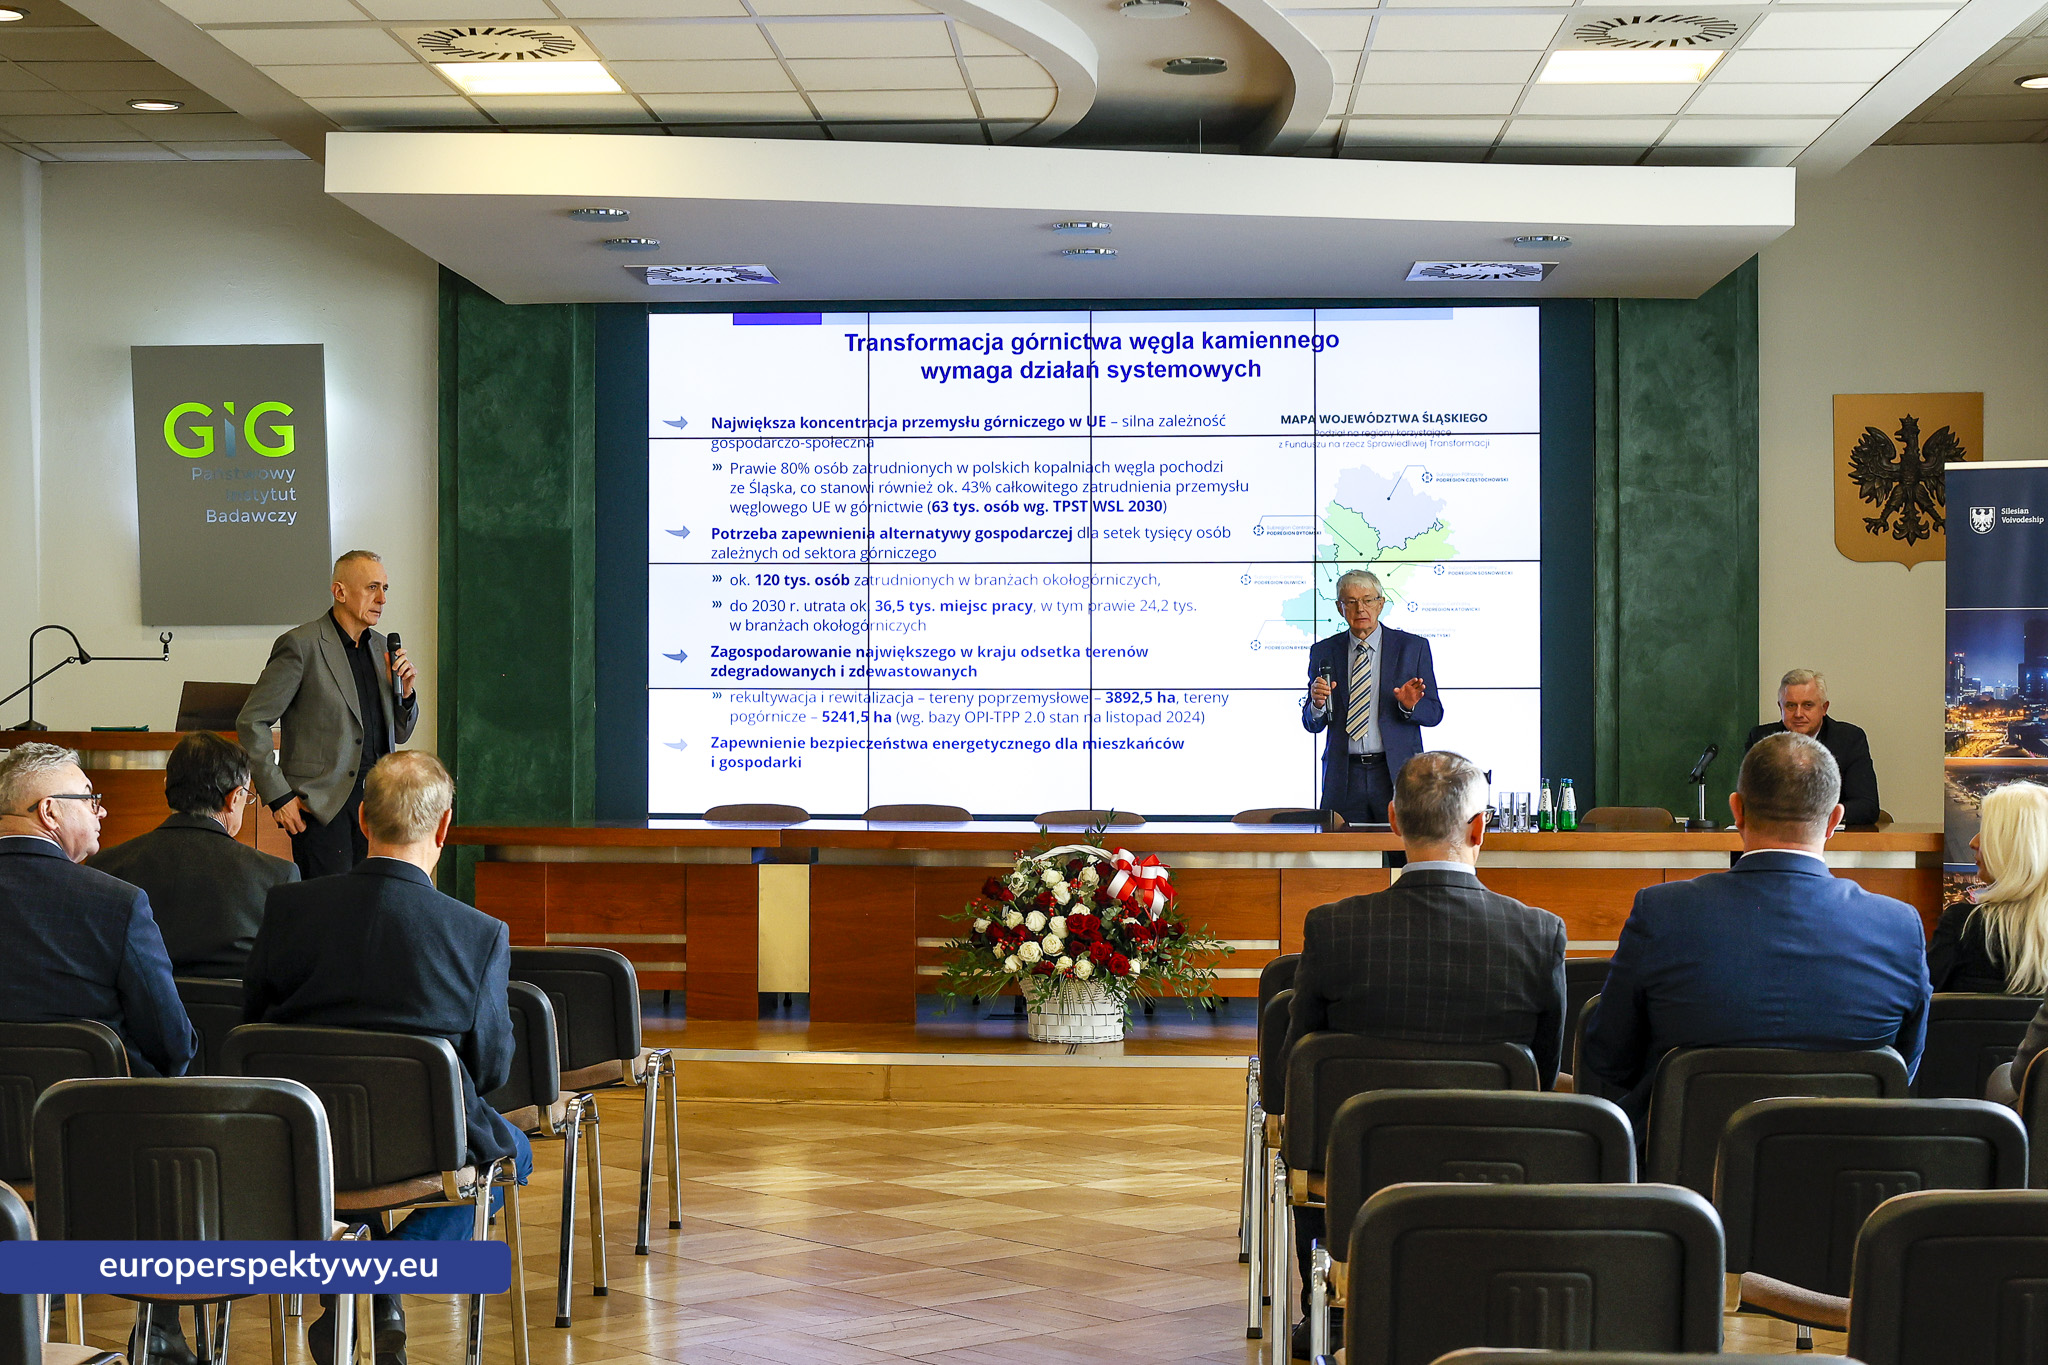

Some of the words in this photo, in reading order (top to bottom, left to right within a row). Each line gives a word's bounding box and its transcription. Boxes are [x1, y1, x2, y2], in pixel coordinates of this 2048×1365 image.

[845, 333, 1002, 354] Transformacja
[1011, 333, 1121, 354] górnictwa
[1130, 332, 1194, 353] węgla
[1202, 331, 1340, 352] kamiennego
[921, 365, 1013, 384] wymaga
[1020, 361, 1099, 379] działań
[1107, 359, 1261, 382] systemowych
[712, 417, 796, 432] Największa
[800, 416, 897, 431] koncentracja
[902, 416, 979, 431] przemysłu
[984, 416, 1065, 431] górniczego
[1069, 418, 1082, 427] w
[1087, 416, 1106, 427] UE
[1123, 415, 1154, 427] silna
[1159, 414, 1226, 430] zależność
[1281, 415, 1315, 424] MAPA
[1319, 412, 1419, 424] WOJEWÓDZTWA
[1423, 412, 1488, 425] ŚLĄSKIEGO
[712, 436, 874, 452] gospodarczo-społeczna
[1367, 440, 1427, 449] Sprawiedliwej
[1430, 440, 1490, 449] Transformacji
[730, 462, 776, 474] Prawie
[781, 463, 810, 474] 80%
[814, 461, 848, 474] osób
[853, 461, 952, 478] zatrudnionych
[957, 464, 968, 473] w
[973, 461, 1029, 478] polskich
[1034, 460, 1110, 477] kopalniach
[1115, 460, 1155, 476] węgla
[1159, 460, 1223, 476] pochodzi
[730, 484, 744, 494] ze
[749, 478, 796, 498] Śląska,
[800, 484, 816, 494] co
[820, 481, 874, 494] stanowi
[879, 481, 933, 494] również
[937, 481, 958, 493] ok.
[962, 481, 991, 493] 43%
[996, 480, 1078, 496] całkowitego
[1083, 480, 1171, 494] zatrudnienia
[1176, 479, 1249, 496] przemysłu
[730, 500, 807, 517] węglowego
[812, 502, 831, 514] UE
[835, 504, 846, 513] w
[850, 500, 923, 517] górnictwie
[927, 500, 949, 516] (63
[953, 501, 979, 517] tys.
[984, 500, 1019, 513] osób
[1024, 503, 1048, 516] wg.
[1053, 501, 1088, 513] TPST
[1092, 500, 1124, 512] WSL
[1128, 500, 1167, 515] 2030)
[206, 509, 297, 525] Badawczy
[2002, 516, 2044, 524] Voivodeship
[712, 527, 777, 541] Potrzeba
[782, 527, 875, 543] zapewnienia
[880, 527, 971, 542] alternatywy
[975, 527, 1073, 542] gospodarczej
[1077, 526, 1099, 538] dla
[1103, 526, 1140, 538] setek
[1144, 527, 1192, 542] tysięcy
[1196, 526, 1231, 538] osób
[712, 546, 777, 562] zależnych
[782, 546, 800, 559] od
[804, 546, 856, 559] sektora
[860, 547, 937, 562] górniczego
[730, 574, 750, 586] ok.
[756, 574, 780, 586] 120
[784, 575, 810, 589] tys.
[815, 573, 850, 586] osób
[854, 573, 954, 590] zatrudnionych
[959, 576, 970, 585] w
[975, 573, 1038, 586] branżach
[1043, 573, 1161, 589] okołogórniczych,
[730, 600, 748, 612] do
[752, 601, 785, 612] 2030
[790, 603, 799, 612] r.
[804, 601, 846, 612] utrata
[875, 600, 905, 614] 36,5
[909, 601, 936, 615] tys.
[940, 600, 987, 615] miejsc
[992, 602, 1036, 615] pracy,
[1041, 602, 1053, 611] w
[1057, 601, 1083, 615] tym
[1088, 600, 1135, 615] prawie
[1140, 600, 1169, 614] 24,2
[1173, 601, 1197, 615] tys.
[730, 622, 741, 631] w
[746, 619, 809, 632] branżach
[813, 619, 926, 635] okołogórniczych
[711, 645, 851, 661] Zagospodarowanie
[856, 646, 956, 661] największego
[961, 649, 973, 658] w
[978, 645, 1016, 661] kraju
[1021, 645, 1081, 658] odsetka
[1085, 645, 1148, 658] terenów
[711, 665, 836, 680] zdegradowanych
[840, 665, 844, 677] i
[849, 665, 977, 681] zdewastowanych
[730, 691, 816, 706] rekultywacja
[821, 692, 824, 703] i
[828, 691, 913, 707] rewitalizacja
[929, 694, 974, 707] tereny
[978, 691, 1089, 707] poprzemysłowe
[1105, 691, 1153, 706] 3892,5
[1157, 691, 1179, 705] ha,
[1184, 694, 1229, 706] tereny
[730, 710, 806, 726] pogórnicze
[822, 711, 869, 726] 5241,5
[874, 711, 891, 723] ha
[896, 711, 925, 727] (wg.
[929, 711, 960, 727] bazy
[965, 712, 1020, 723] OPI-TPP
[1024, 712, 1045, 723] 2.0
[1050, 713, 1080, 723] stan
[1084, 714, 1102, 723] na
[1106, 711, 1162, 727] listopad
[1166, 711, 1205, 726] 2024)
[711, 736, 806, 753] Zapewnienie
[810, 737, 928, 753] bezpieczeństwa
[932, 737, 1051, 753] energetycznego
[1055, 737, 1078, 750] dla
[1082, 737, 1184, 750] mieszkańców
[711, 756, 714, 767] i
[719, 756, 802, 771] gospodarki
